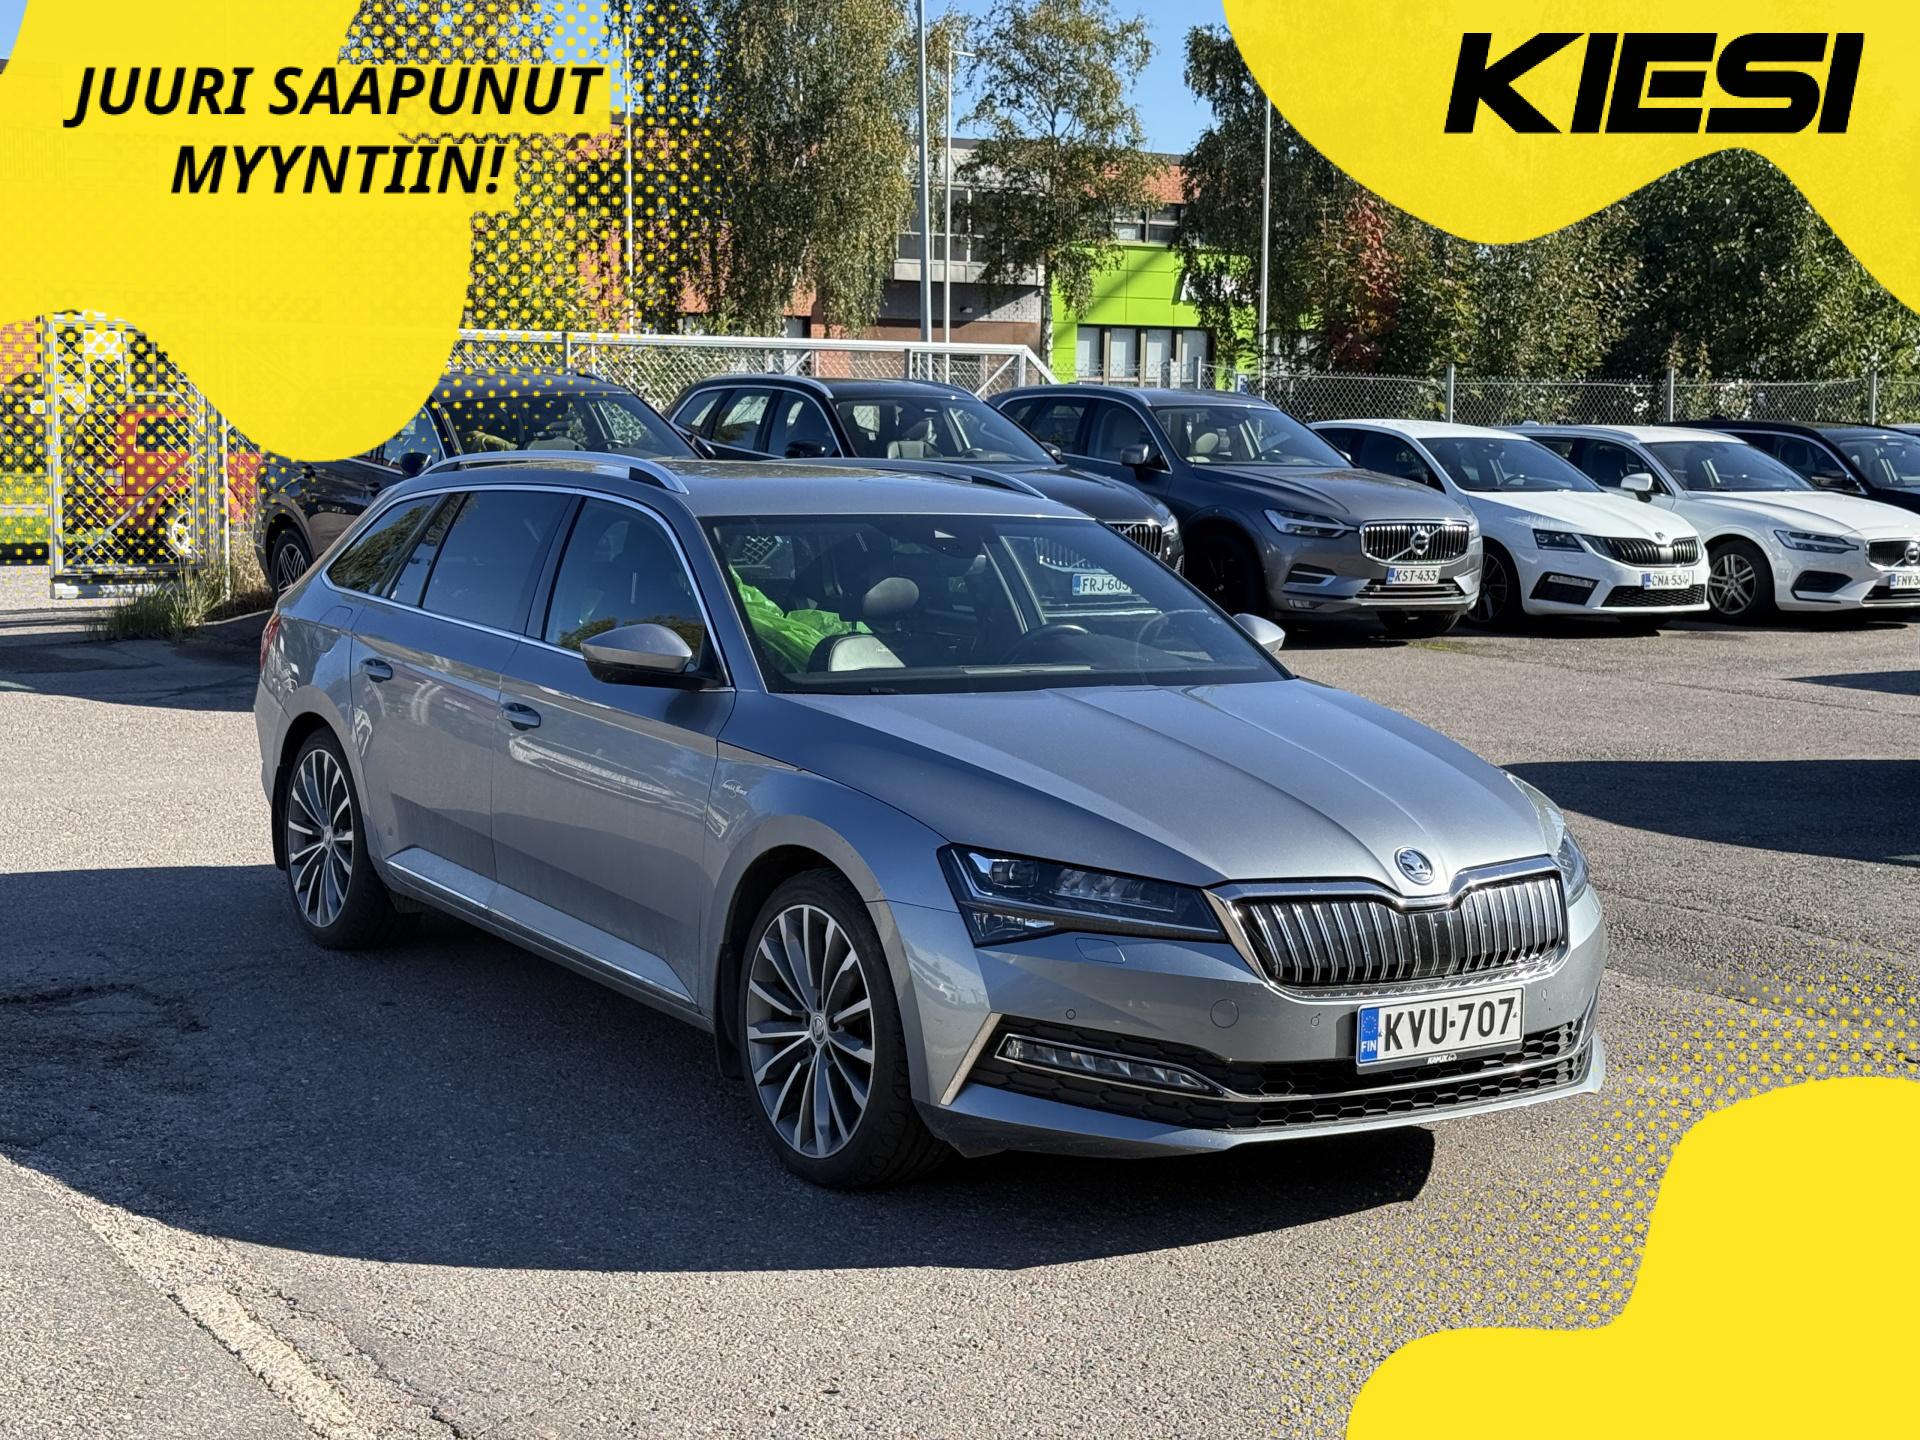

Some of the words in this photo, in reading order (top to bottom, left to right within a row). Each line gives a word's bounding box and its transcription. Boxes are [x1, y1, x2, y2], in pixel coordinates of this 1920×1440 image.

[1896, 575, 1920, 586] FNY-3
[1384, 997, 1516, 1052] KVU-707
[1361, 1039, 1377, 1053] FIN
